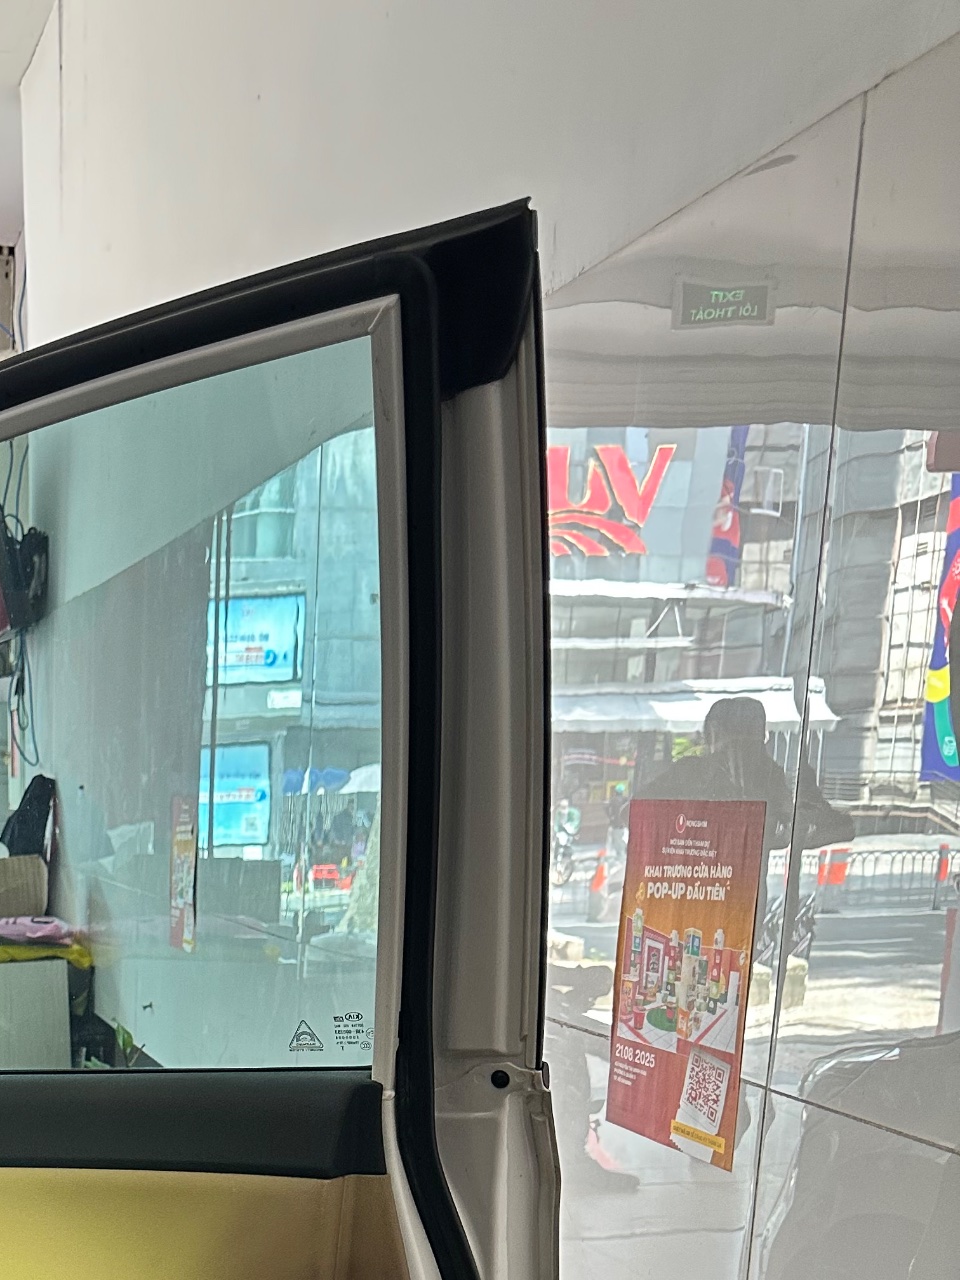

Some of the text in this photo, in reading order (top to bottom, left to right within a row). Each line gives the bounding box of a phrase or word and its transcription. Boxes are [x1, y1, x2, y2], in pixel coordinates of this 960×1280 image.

[645, 862, 733, 879] KHAI TRƯƠNG CỬA HÀNG
[647, 882, 685, 900] POP-UP
[707, 883, 726, 901] TIÊN
